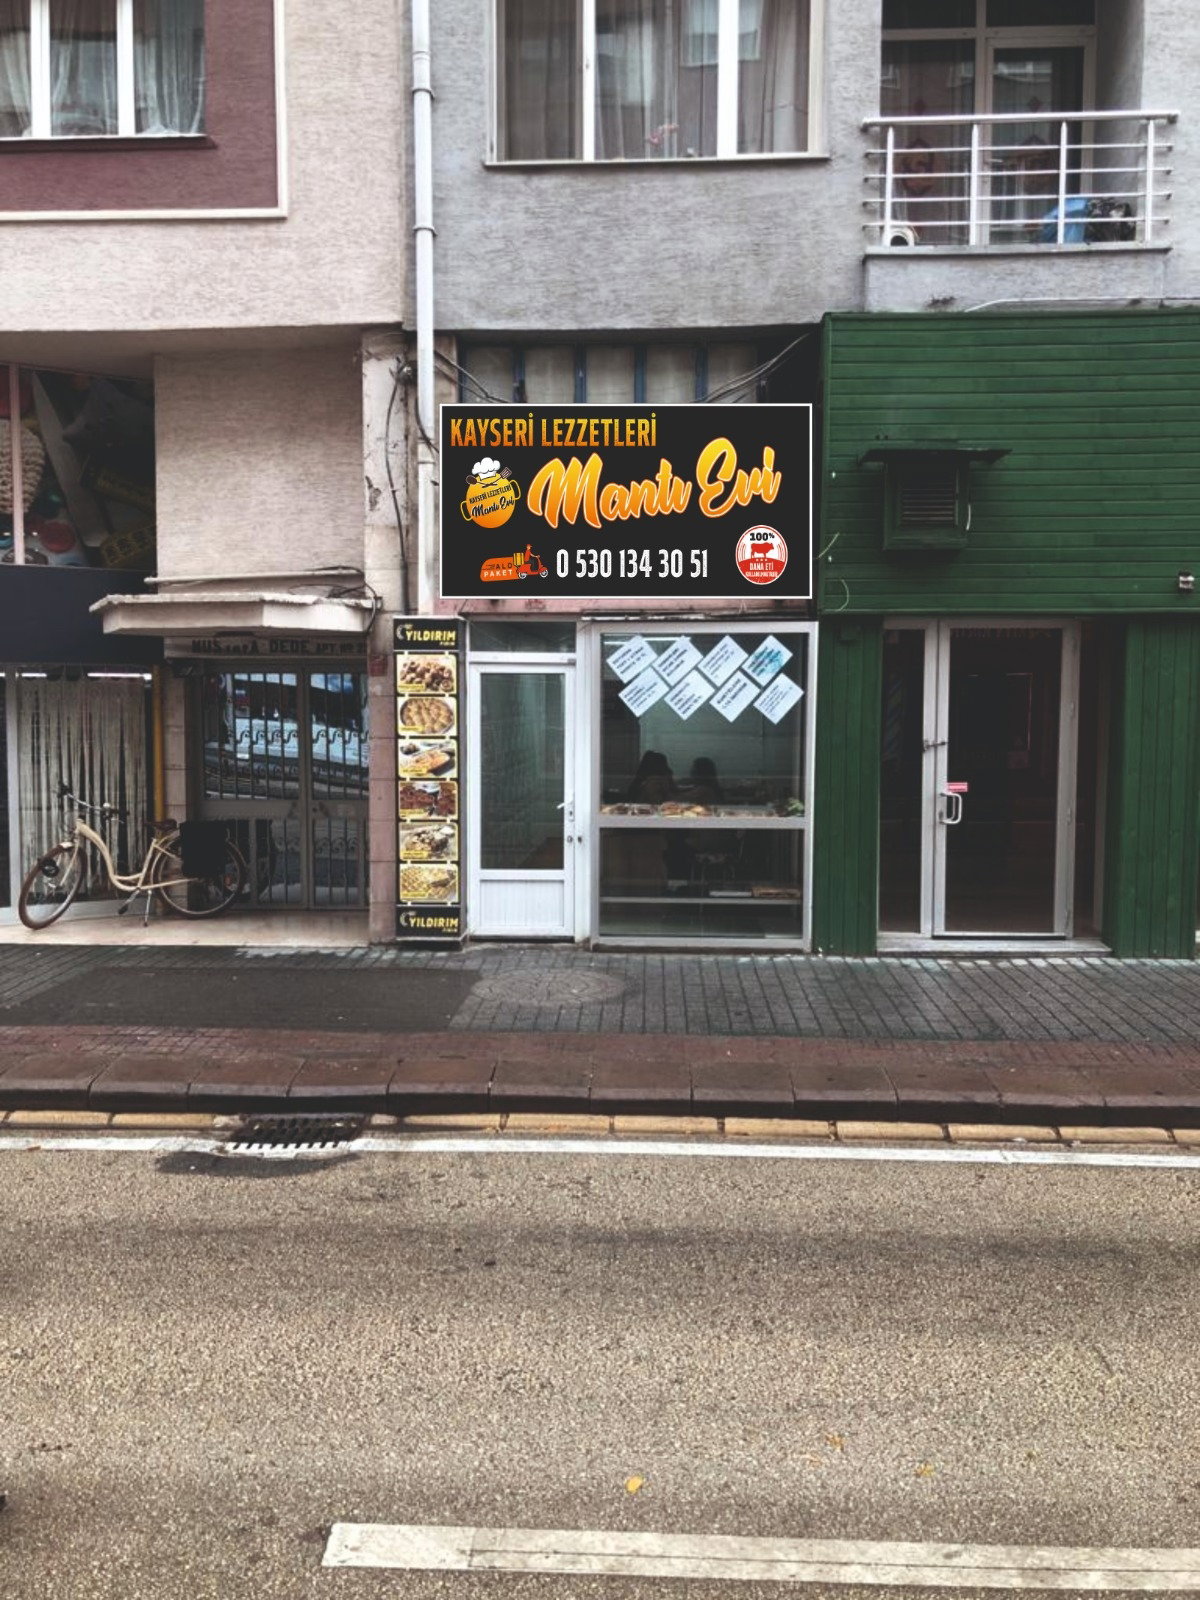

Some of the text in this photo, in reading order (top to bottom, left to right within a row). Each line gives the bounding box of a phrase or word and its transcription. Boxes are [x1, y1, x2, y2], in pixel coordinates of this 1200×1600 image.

[450, 413, 657, 447] KAYSERİ LEZZETLERİ
[696, 437, 782, 518] Evi
[556, 549, 708, 578] 0 530 134 30 51
[750, 562, 774, 570] DANA ETİ
[405, 630, 456, 641] YILDIRIM
[409, 917, 459, 928] YILDIRIM
